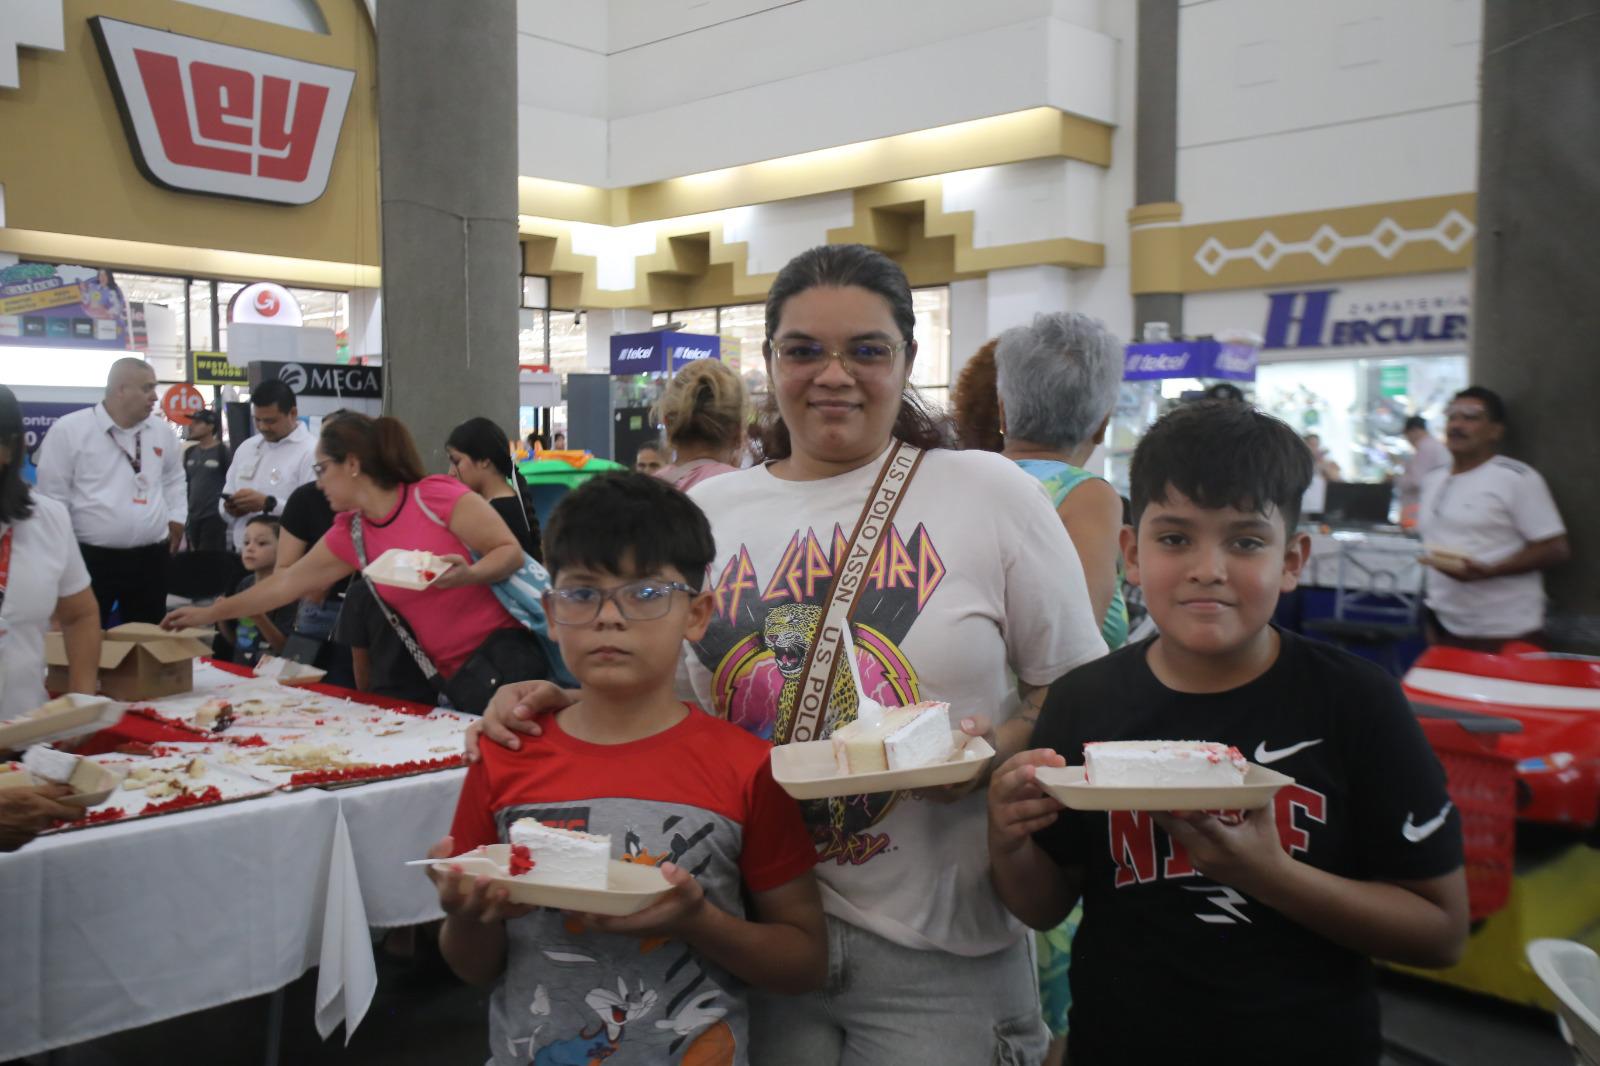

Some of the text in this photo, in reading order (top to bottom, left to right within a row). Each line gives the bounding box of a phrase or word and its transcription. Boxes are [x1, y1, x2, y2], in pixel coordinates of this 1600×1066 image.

[626, 346, 655, 360] telcel
[682, 346, 713, 360] telcel
[311, 367, 379, 391] MEGA
[169, 387, 202, 409] ria
[885, 454, 912, 483] U.S.
[861, 488, 897, 540] POLO
[832, 543, 869, 607] ASSN.
[813, 626, 840, 668] U.S.
[794, 675, 825, 743] POLO
